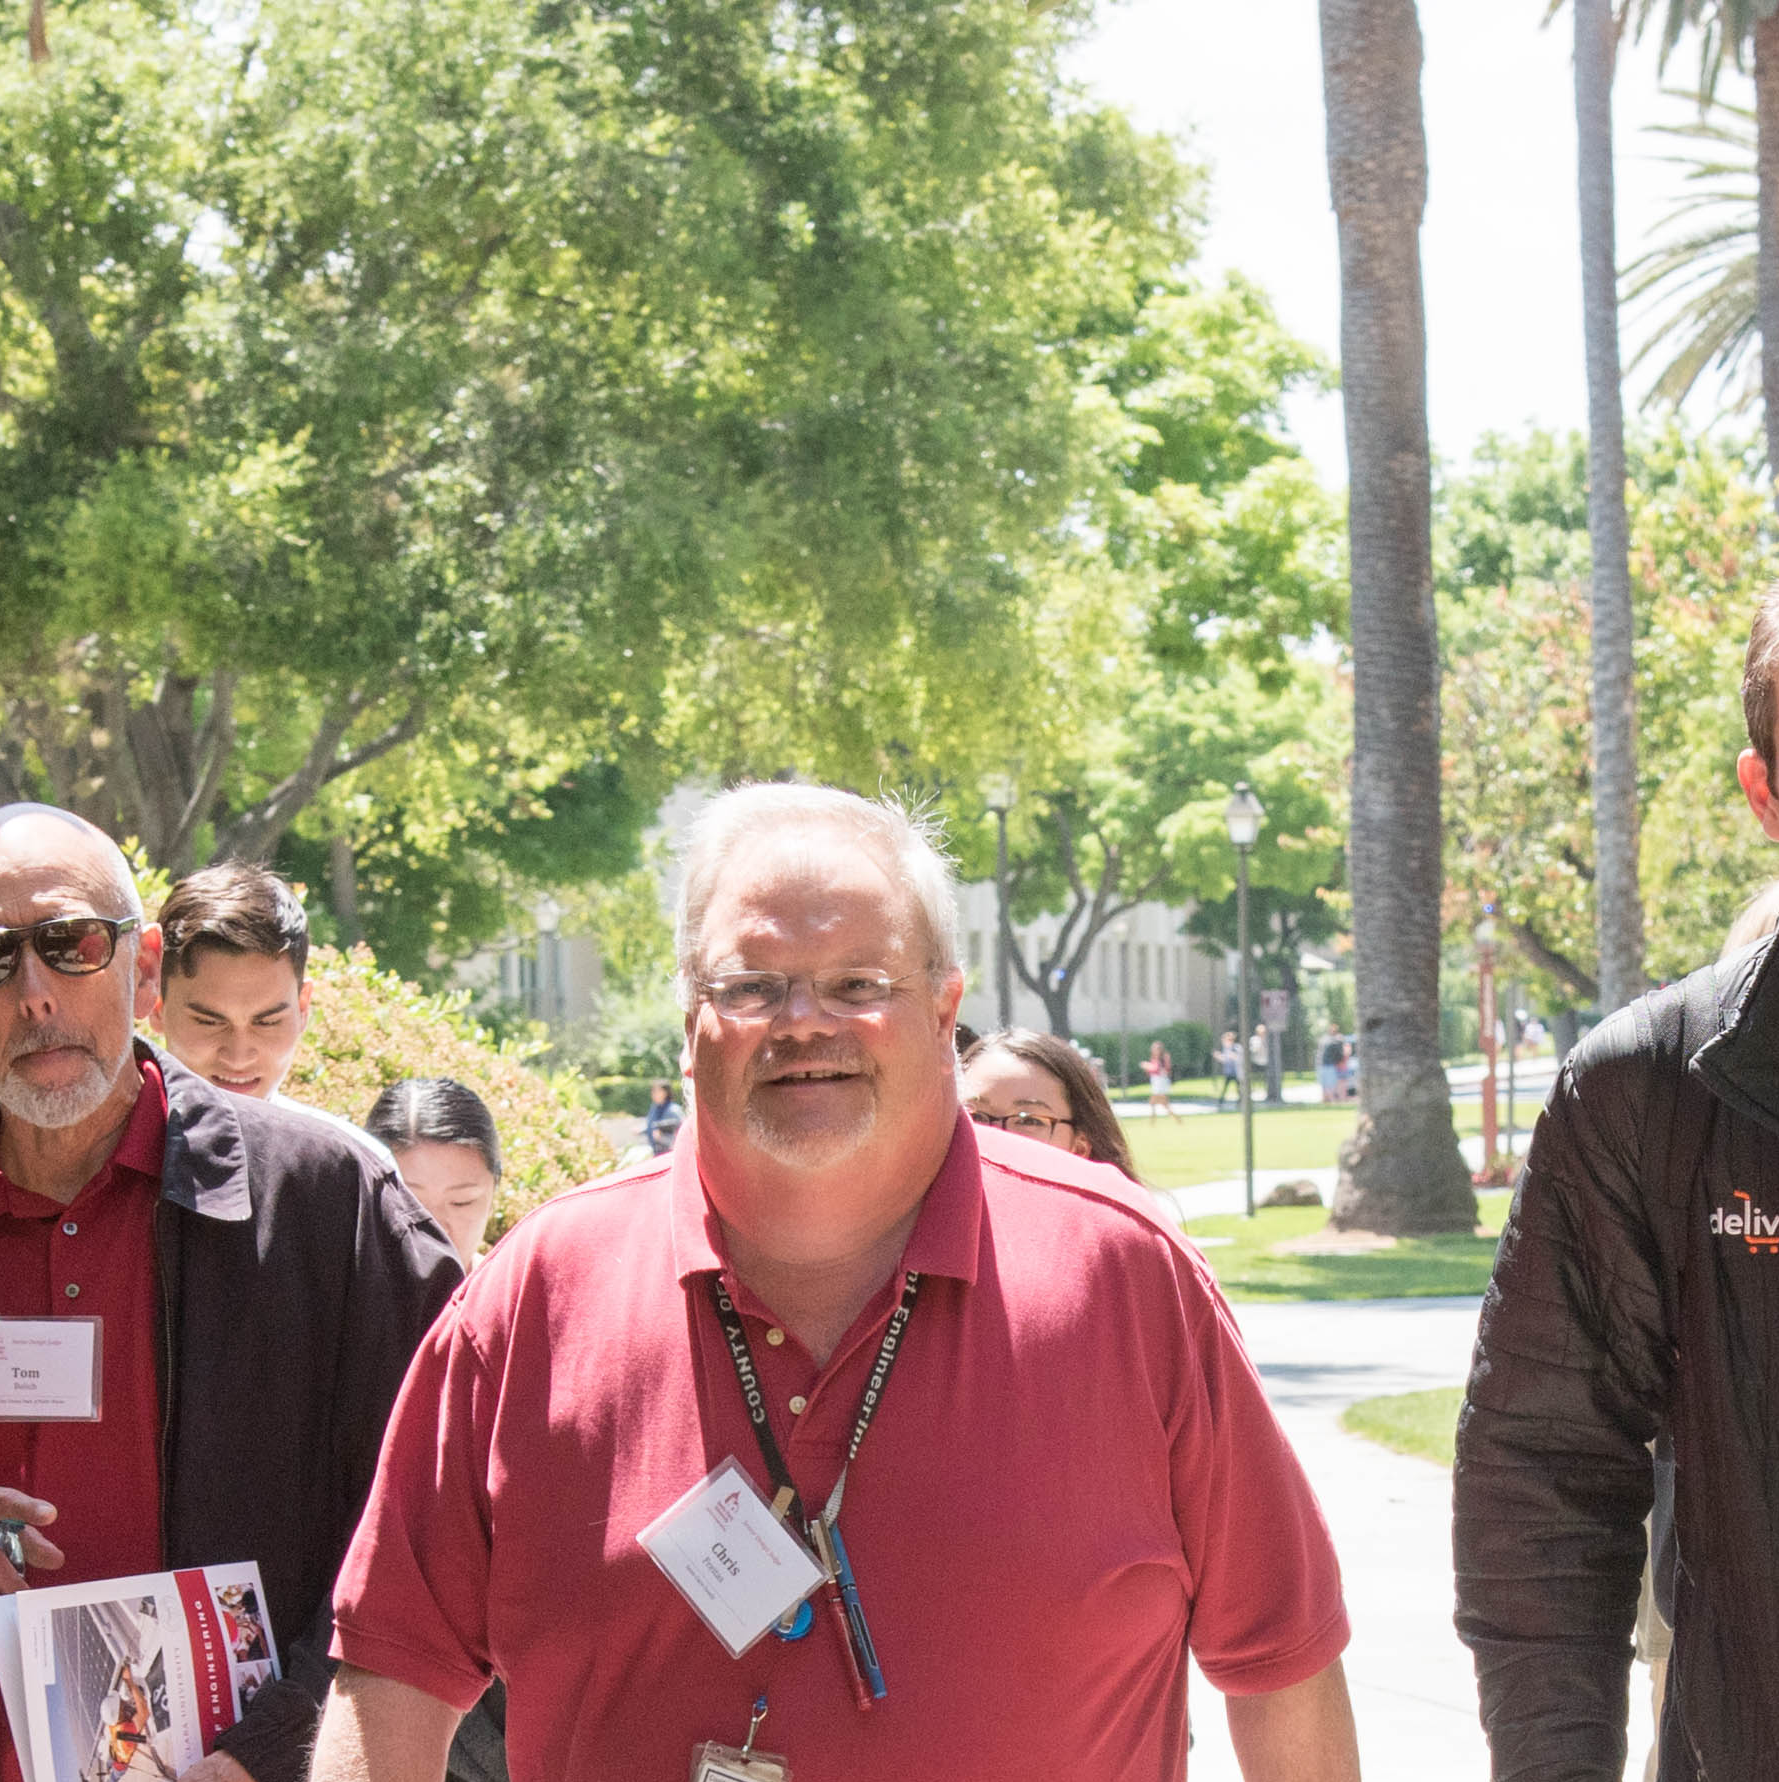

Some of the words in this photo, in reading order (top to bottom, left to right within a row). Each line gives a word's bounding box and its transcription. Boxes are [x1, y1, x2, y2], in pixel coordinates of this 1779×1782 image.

[11, 1367, 40, 1379] Tom
[725, 1321, 766, 1425] COUNTY
[711, 1542, 740, 1576] Chris
[194, 1600, 221, 1714] ENGINEERING
